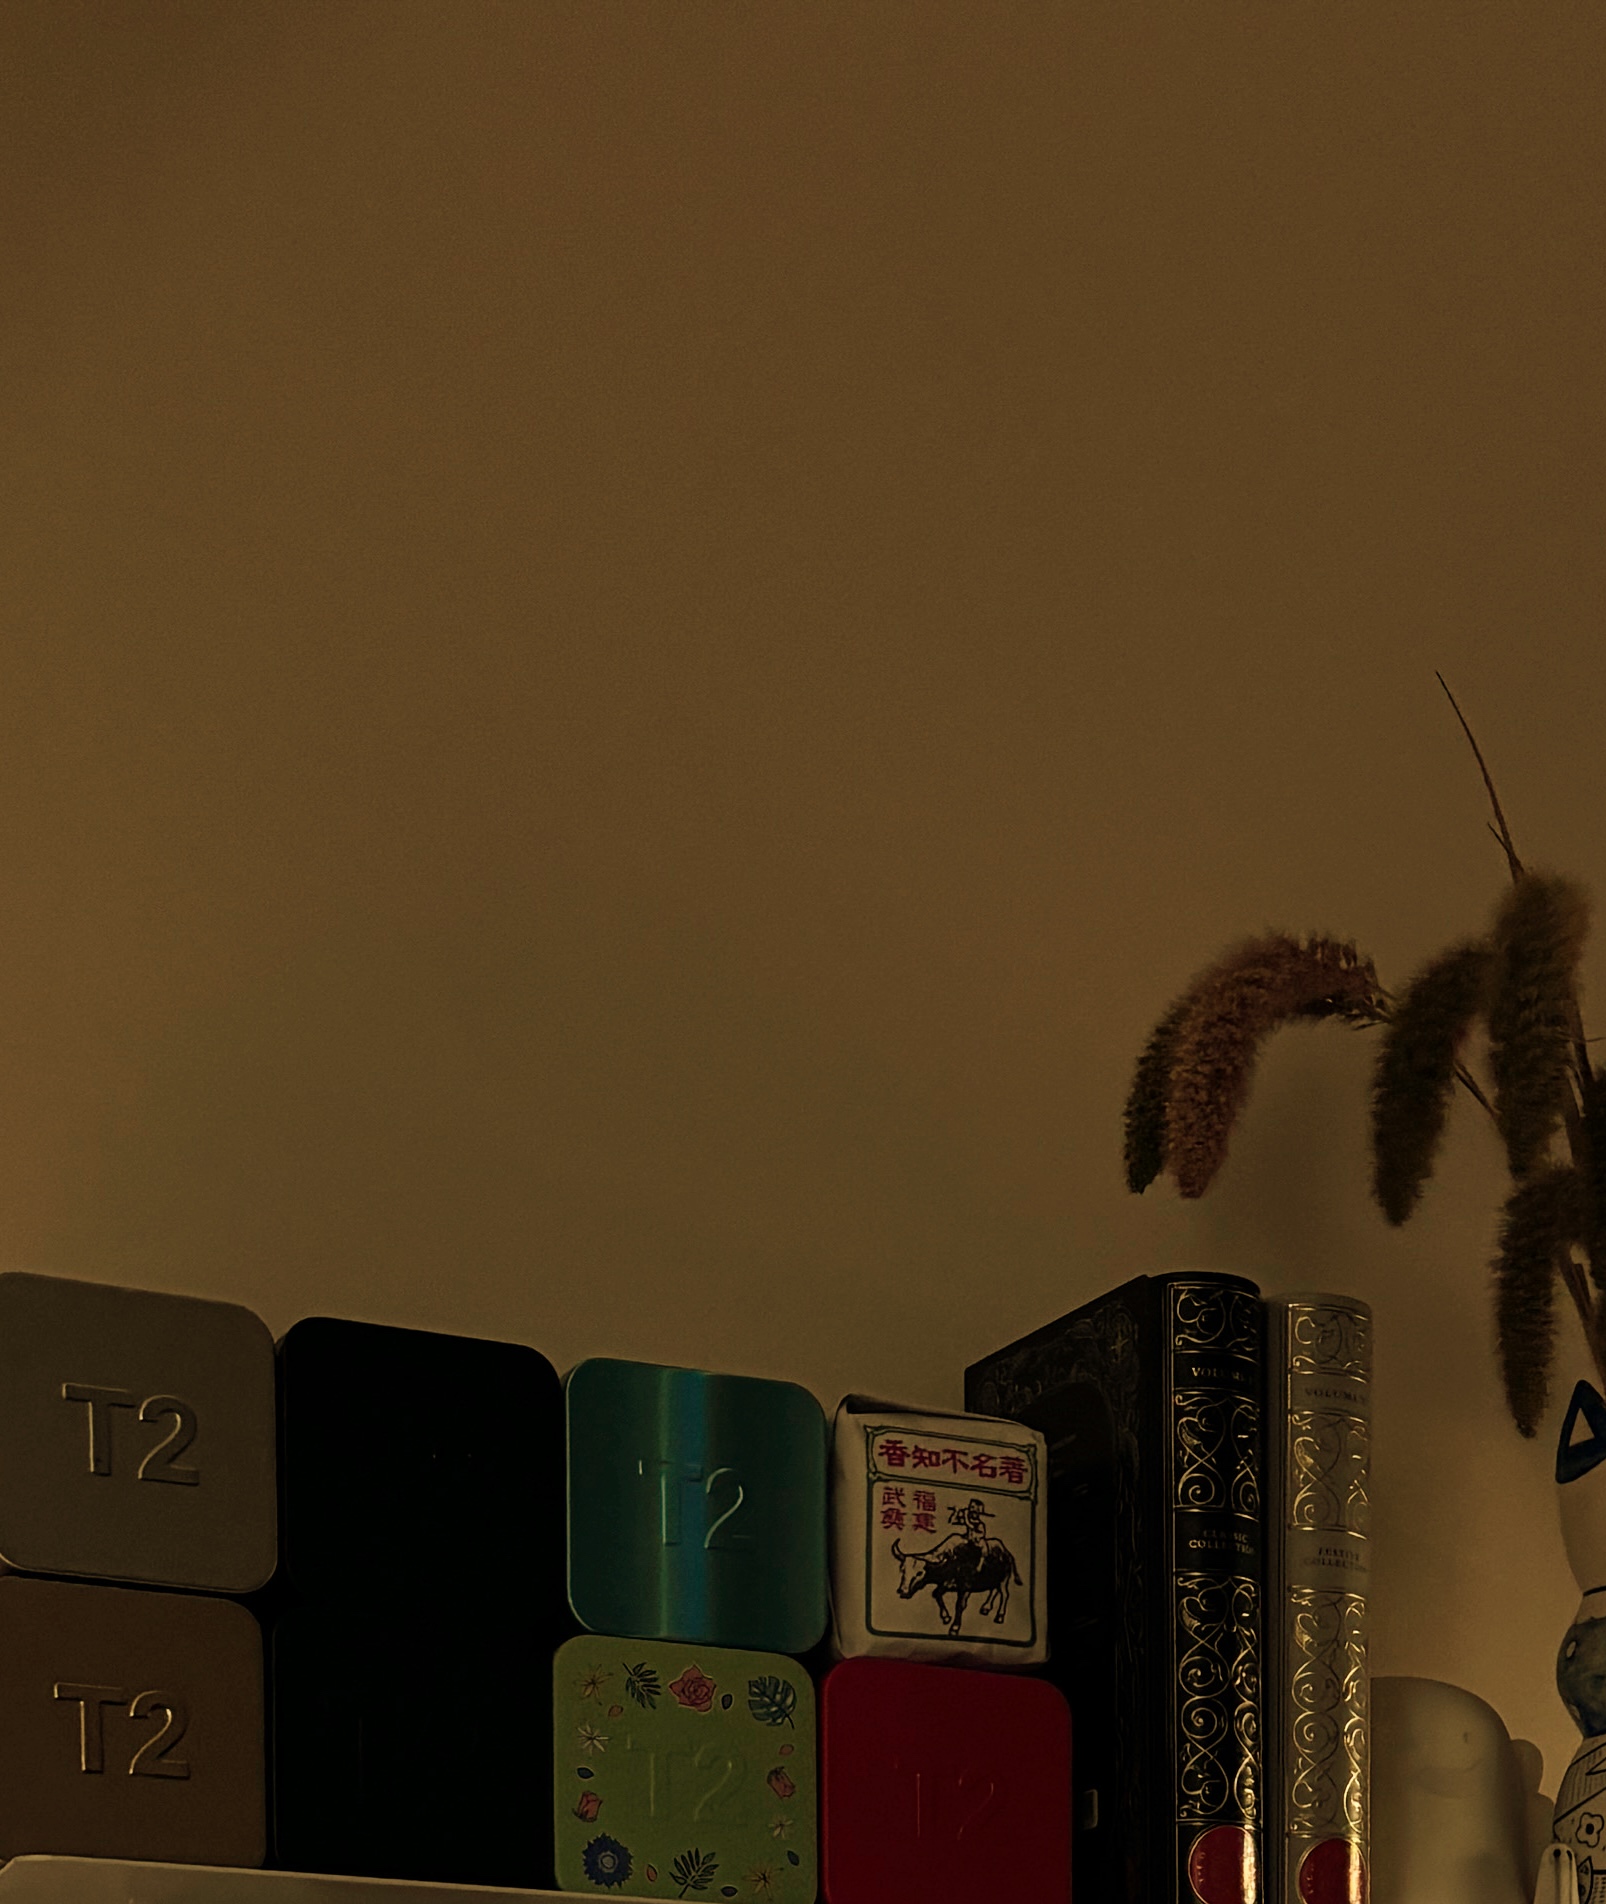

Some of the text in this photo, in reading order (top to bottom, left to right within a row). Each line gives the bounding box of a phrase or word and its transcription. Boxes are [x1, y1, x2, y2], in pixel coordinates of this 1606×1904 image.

[62, 1382, 199, 1486] T2
[638, 1458, 755, 1554] T2
[1188, 1538, 1256, 1555] COLLETION
[1202, 1529, 1249, 1544] CLASIC
[53, 1681, 192, 1780] T2
